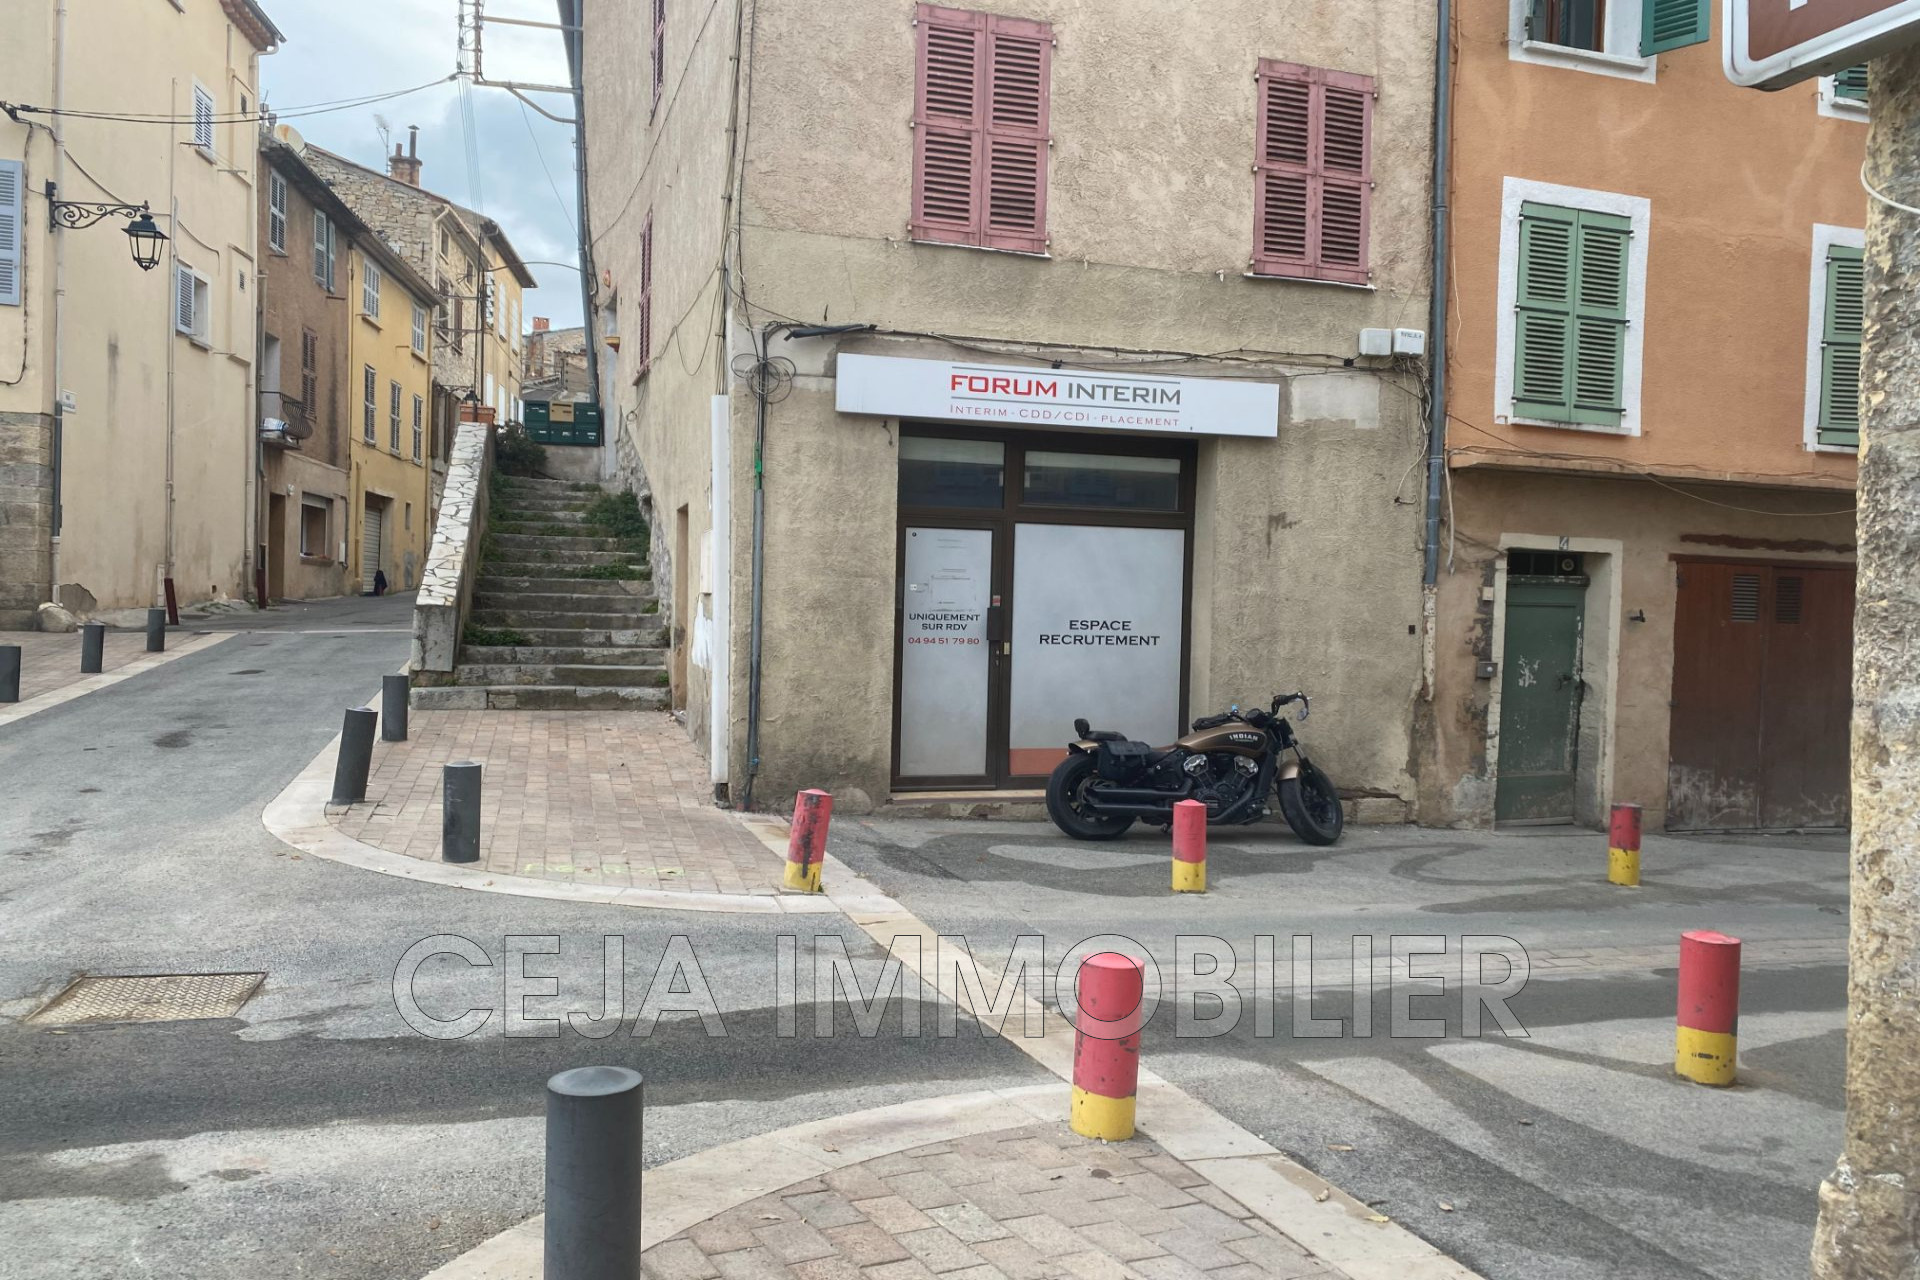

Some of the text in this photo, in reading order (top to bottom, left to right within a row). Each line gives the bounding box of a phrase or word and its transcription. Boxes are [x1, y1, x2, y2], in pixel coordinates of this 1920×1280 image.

[951, 374, 1181, 405] FORUM INTERIM
[950, 404, 1179, 428] INTERIM CDD/CDI PLACEMENT
[1560, 536, 1568, 550] 4
[909, 613, 980, 621] UNIQUEMENT
[921, 623, 943, 631] SUR
[1069, 620, 1132, 631] ESPACE
[1039, 634, 1160, 646] RECRUTEMENT
[1229, 733, 1258, 741] INDIAN
